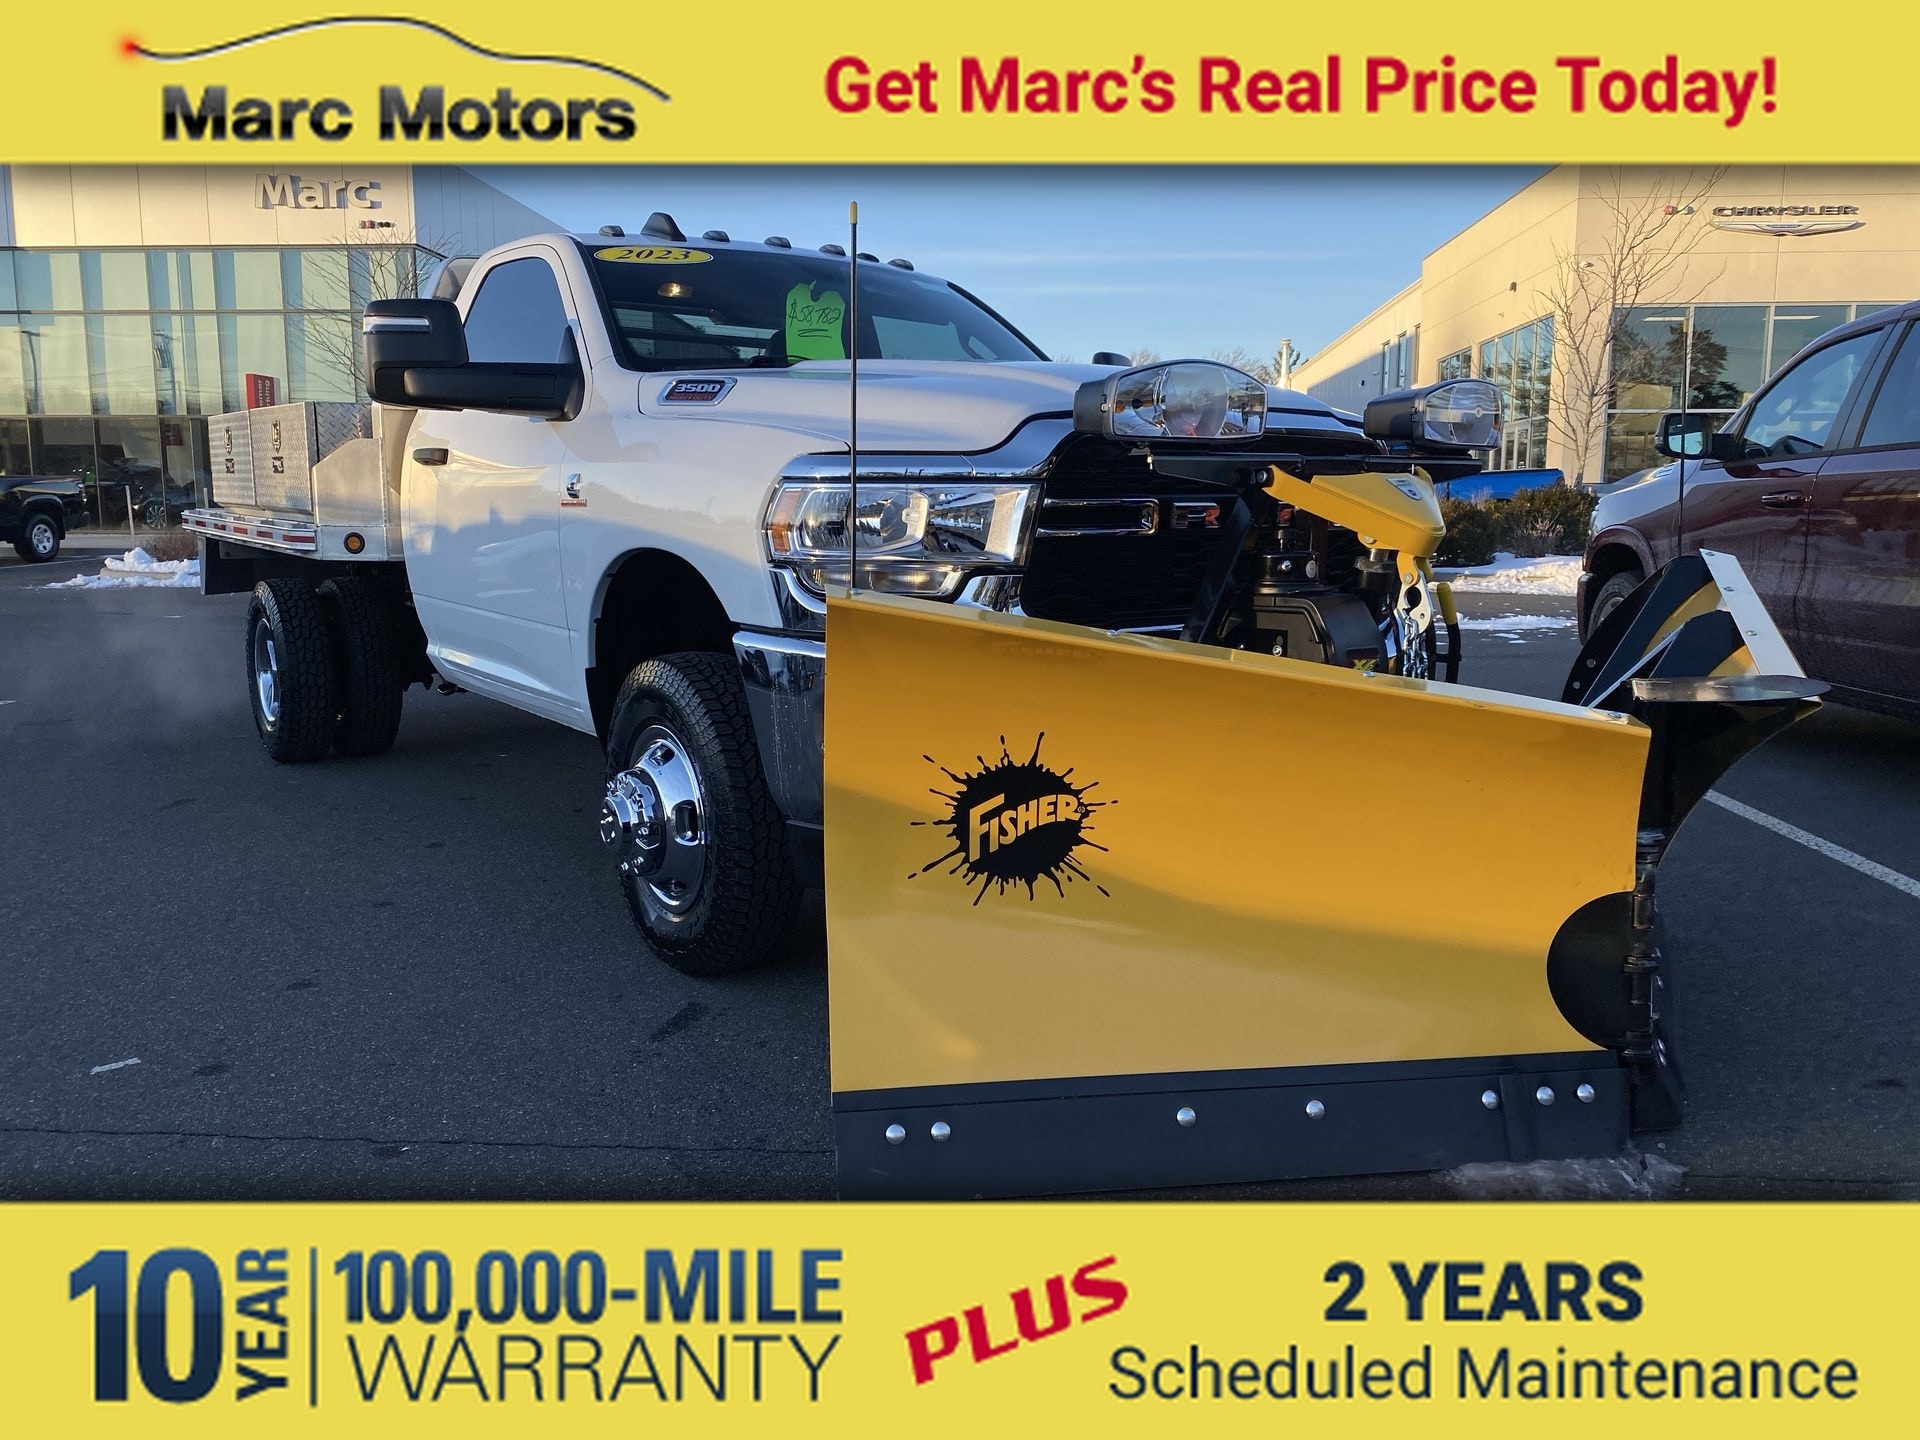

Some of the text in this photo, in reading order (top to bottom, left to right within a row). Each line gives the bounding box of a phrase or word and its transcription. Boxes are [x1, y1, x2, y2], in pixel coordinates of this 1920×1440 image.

[255, 174, 382, 210] Marc
[1713, 205, 1860, 217] CHRYSLER
[615, 249, 691, 260] 2023
[675, 383, 720, 394] 3500
[969, 793, 1081, 863] FISHER
